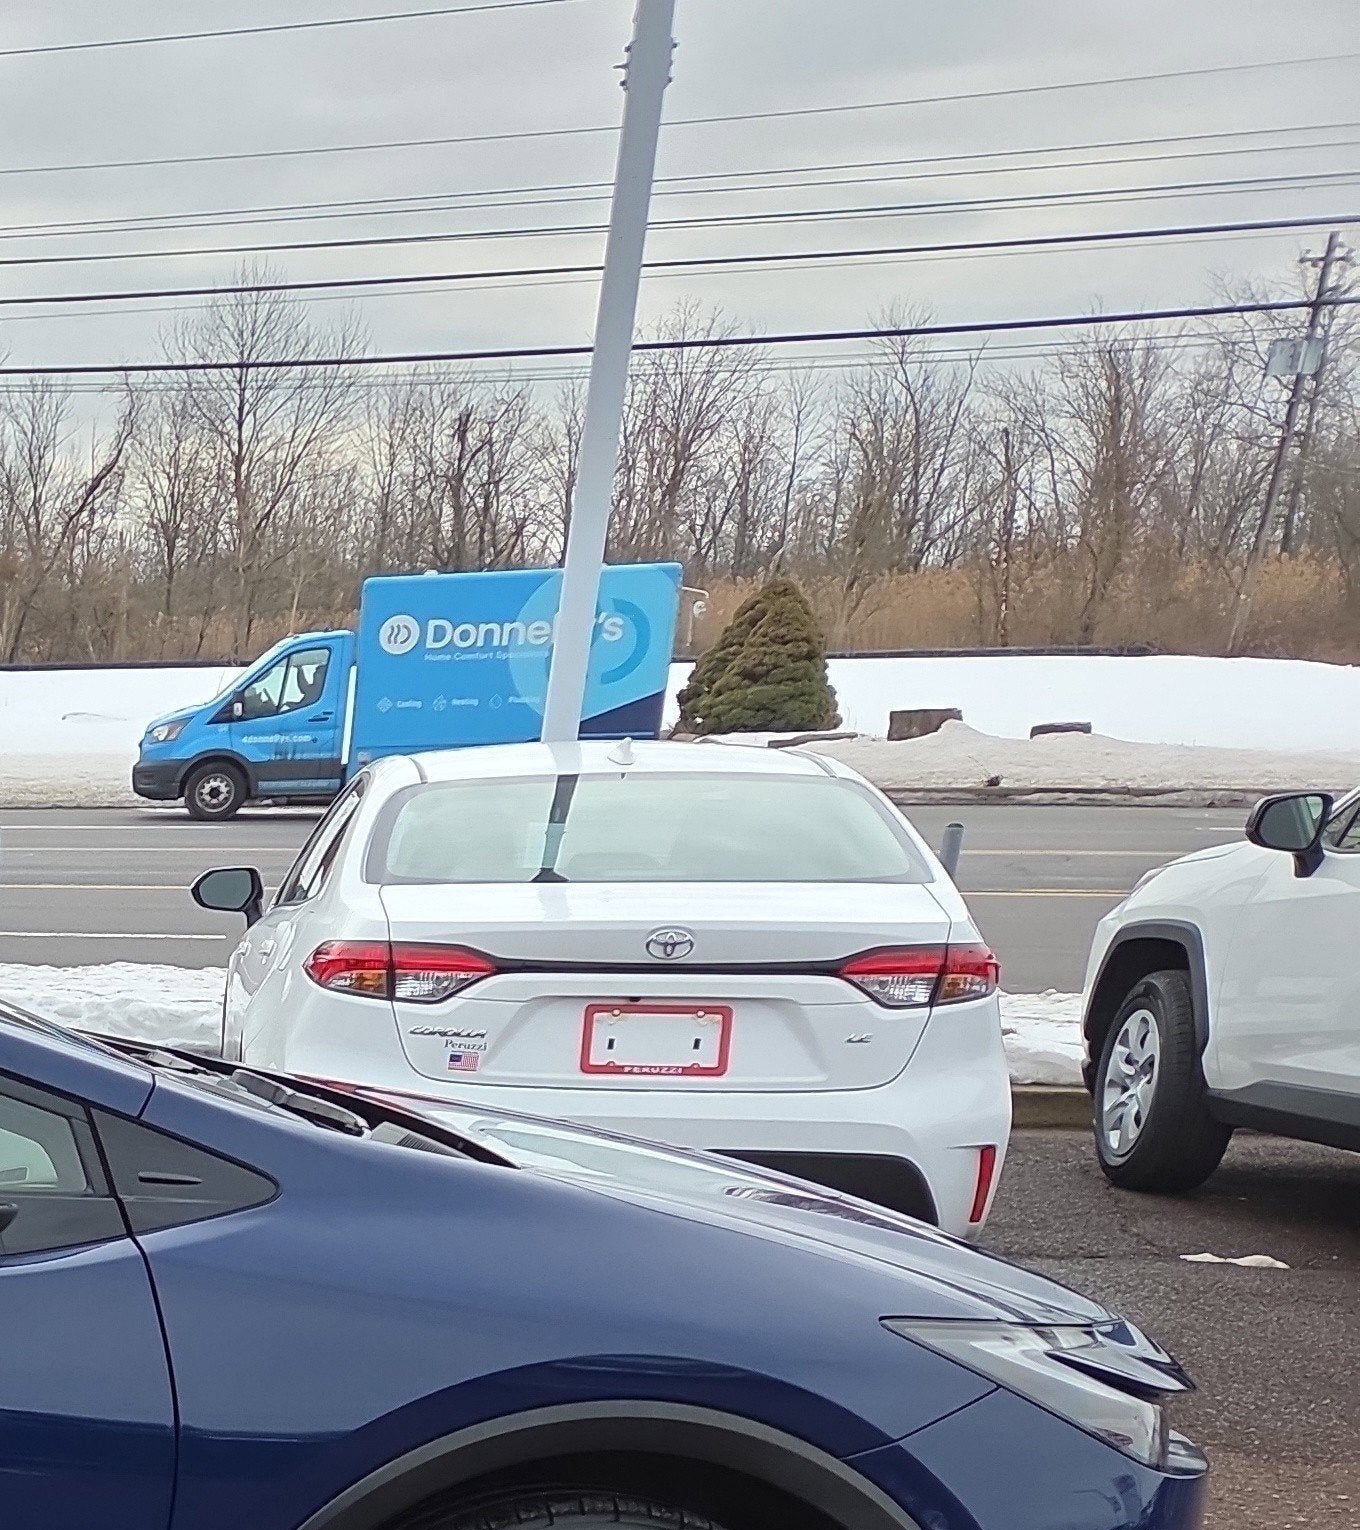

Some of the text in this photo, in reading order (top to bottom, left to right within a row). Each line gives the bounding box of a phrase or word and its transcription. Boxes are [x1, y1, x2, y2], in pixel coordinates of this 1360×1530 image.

[426, 612, 623, 650] Donne's
[444, 1038, 487, 1052] Peruzzi
[623, 1065, 683, 1075] PERUZZI
